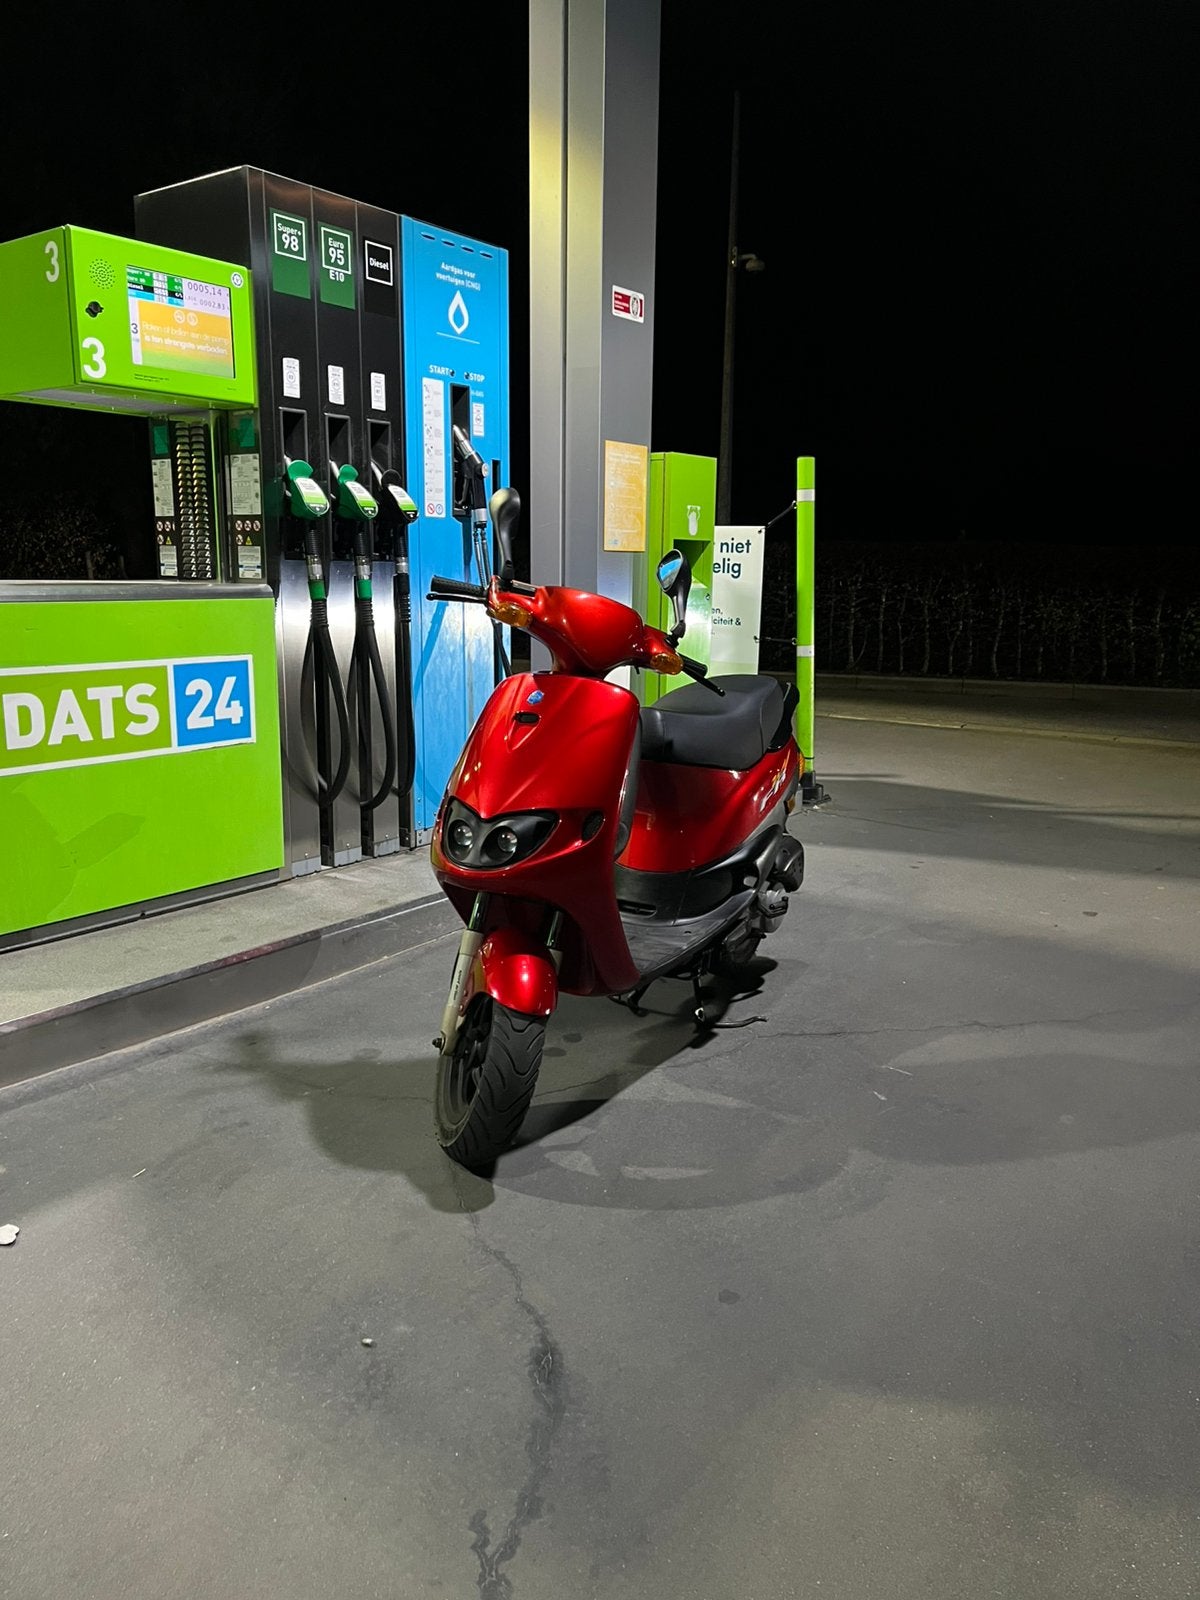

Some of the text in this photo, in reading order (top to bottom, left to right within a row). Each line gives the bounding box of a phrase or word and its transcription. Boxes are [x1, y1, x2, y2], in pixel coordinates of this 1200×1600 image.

[277, 222, 302, 236] Super+
[281, 233, 300, 252] 98
[328, 237, 345, 250] Euro
[44, 240, 60, 283] 3
[328, 247, 345, 266] 95
[369, 257, 389, 271] Diesel
[329, 269, 345, 283] E10
[131, 322, 139, 335] 3
[82, 337, 107, 379] 3
[429, 364, 450, 376] START
[469, 372, 485, 382] STOP
[720, 537, 752, 554] niet
[735, 617, 741, 626] &
[2, 676, 244, 750] DATS 24
